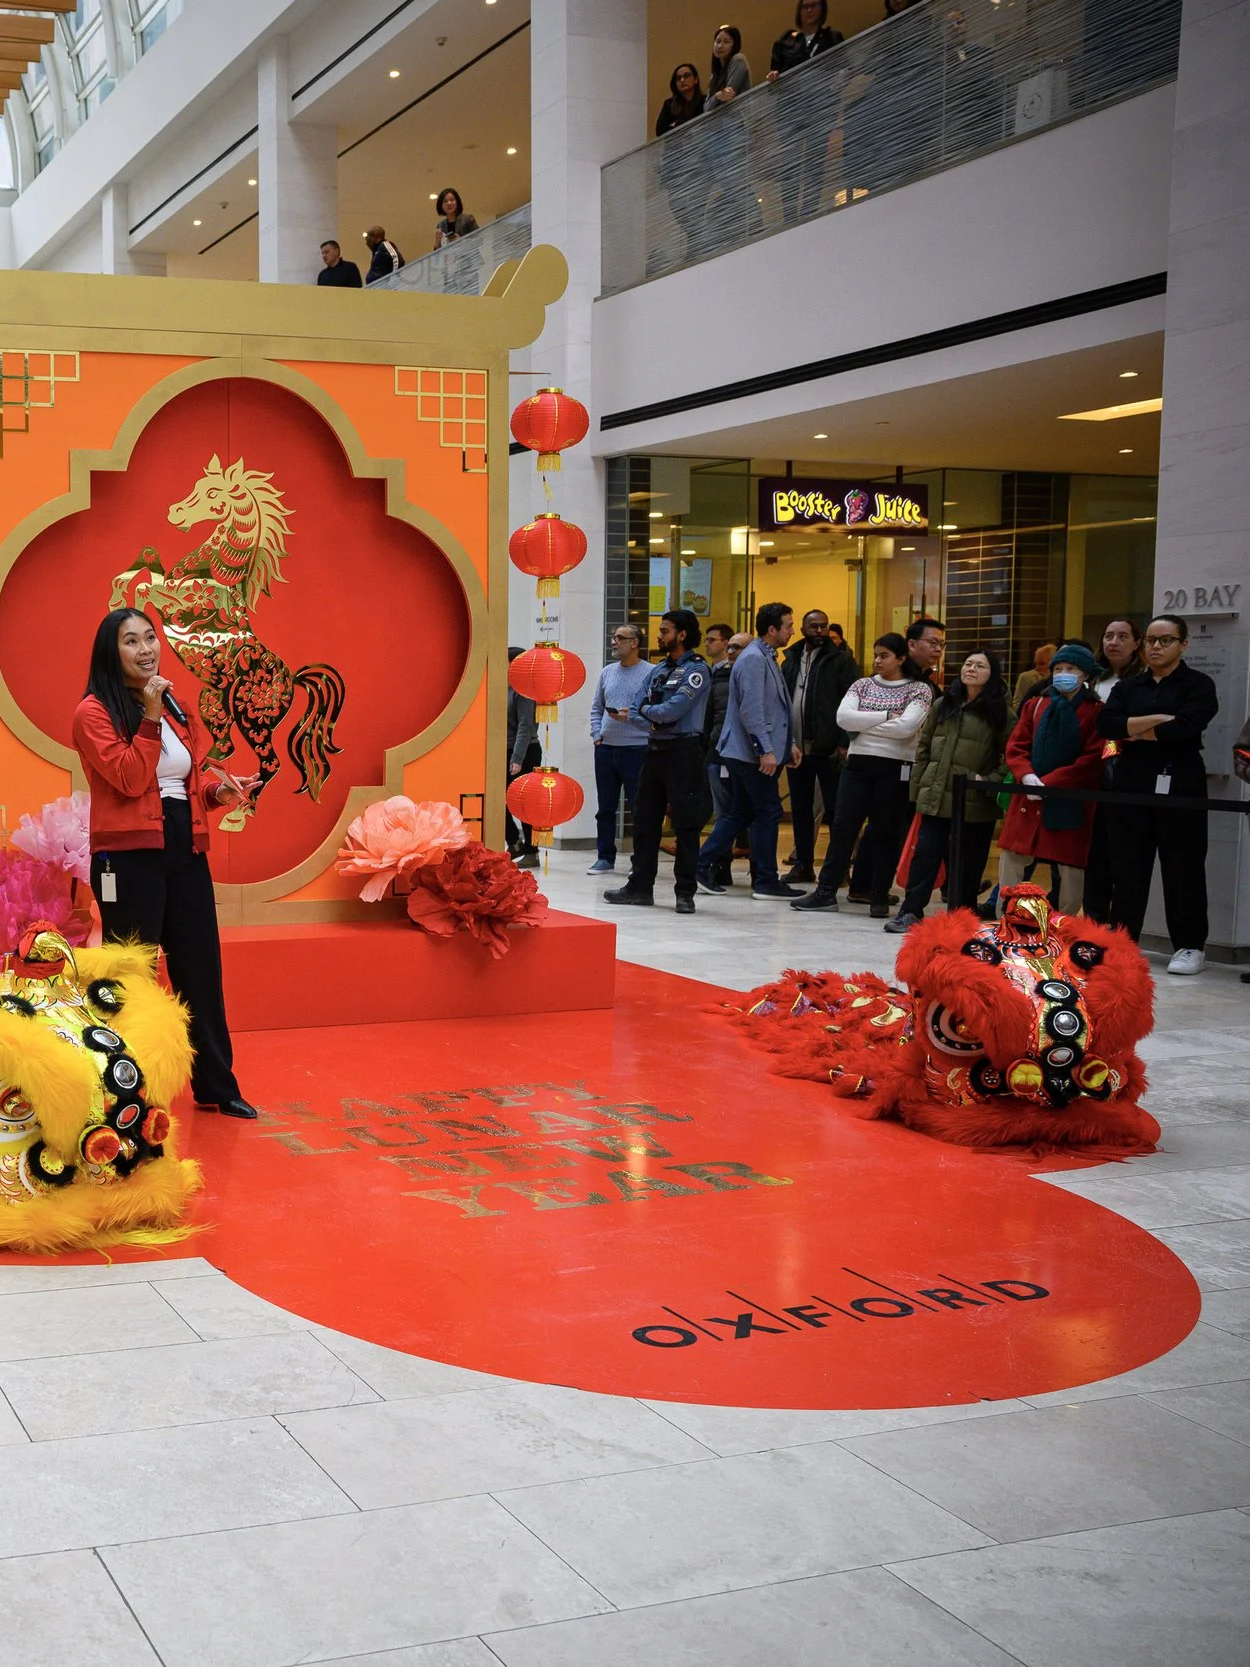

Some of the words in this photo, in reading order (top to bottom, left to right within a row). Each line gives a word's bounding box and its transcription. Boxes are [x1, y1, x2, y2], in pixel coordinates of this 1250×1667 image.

[773, 489, 841, 524] Booster
[868, 492, 922, 526] Juice
[1163, 588, 1188, 610] 20
[1193, 584, 1241, 608] BAY
[266, 1103, 694, 1156] LUNAR
[375, 1132, 675, 1183] NEW
[401, 1161, 794, 1220] YEAR
